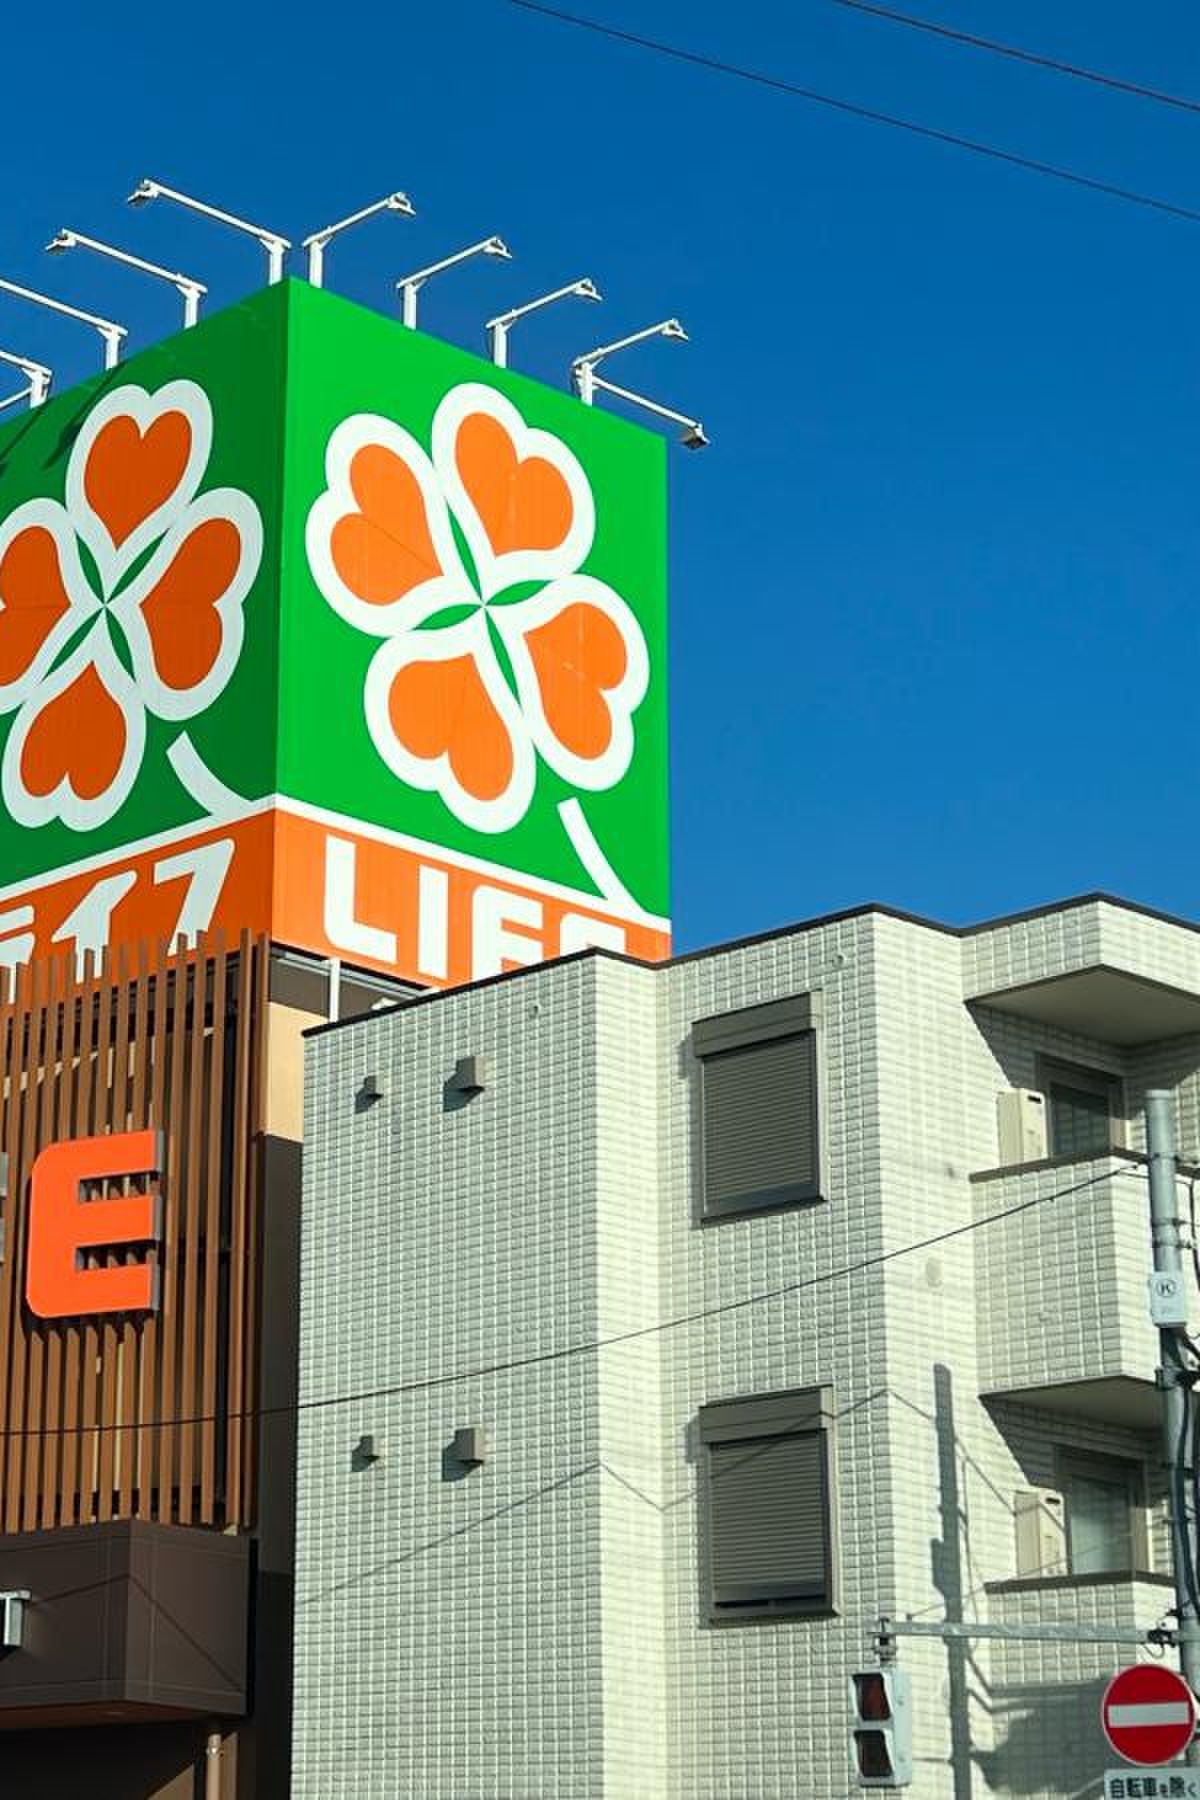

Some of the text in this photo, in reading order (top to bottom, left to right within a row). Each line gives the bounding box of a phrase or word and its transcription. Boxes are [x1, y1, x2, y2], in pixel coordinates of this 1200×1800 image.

[1110, 1776, 1197, 1799] 自転車を除く
